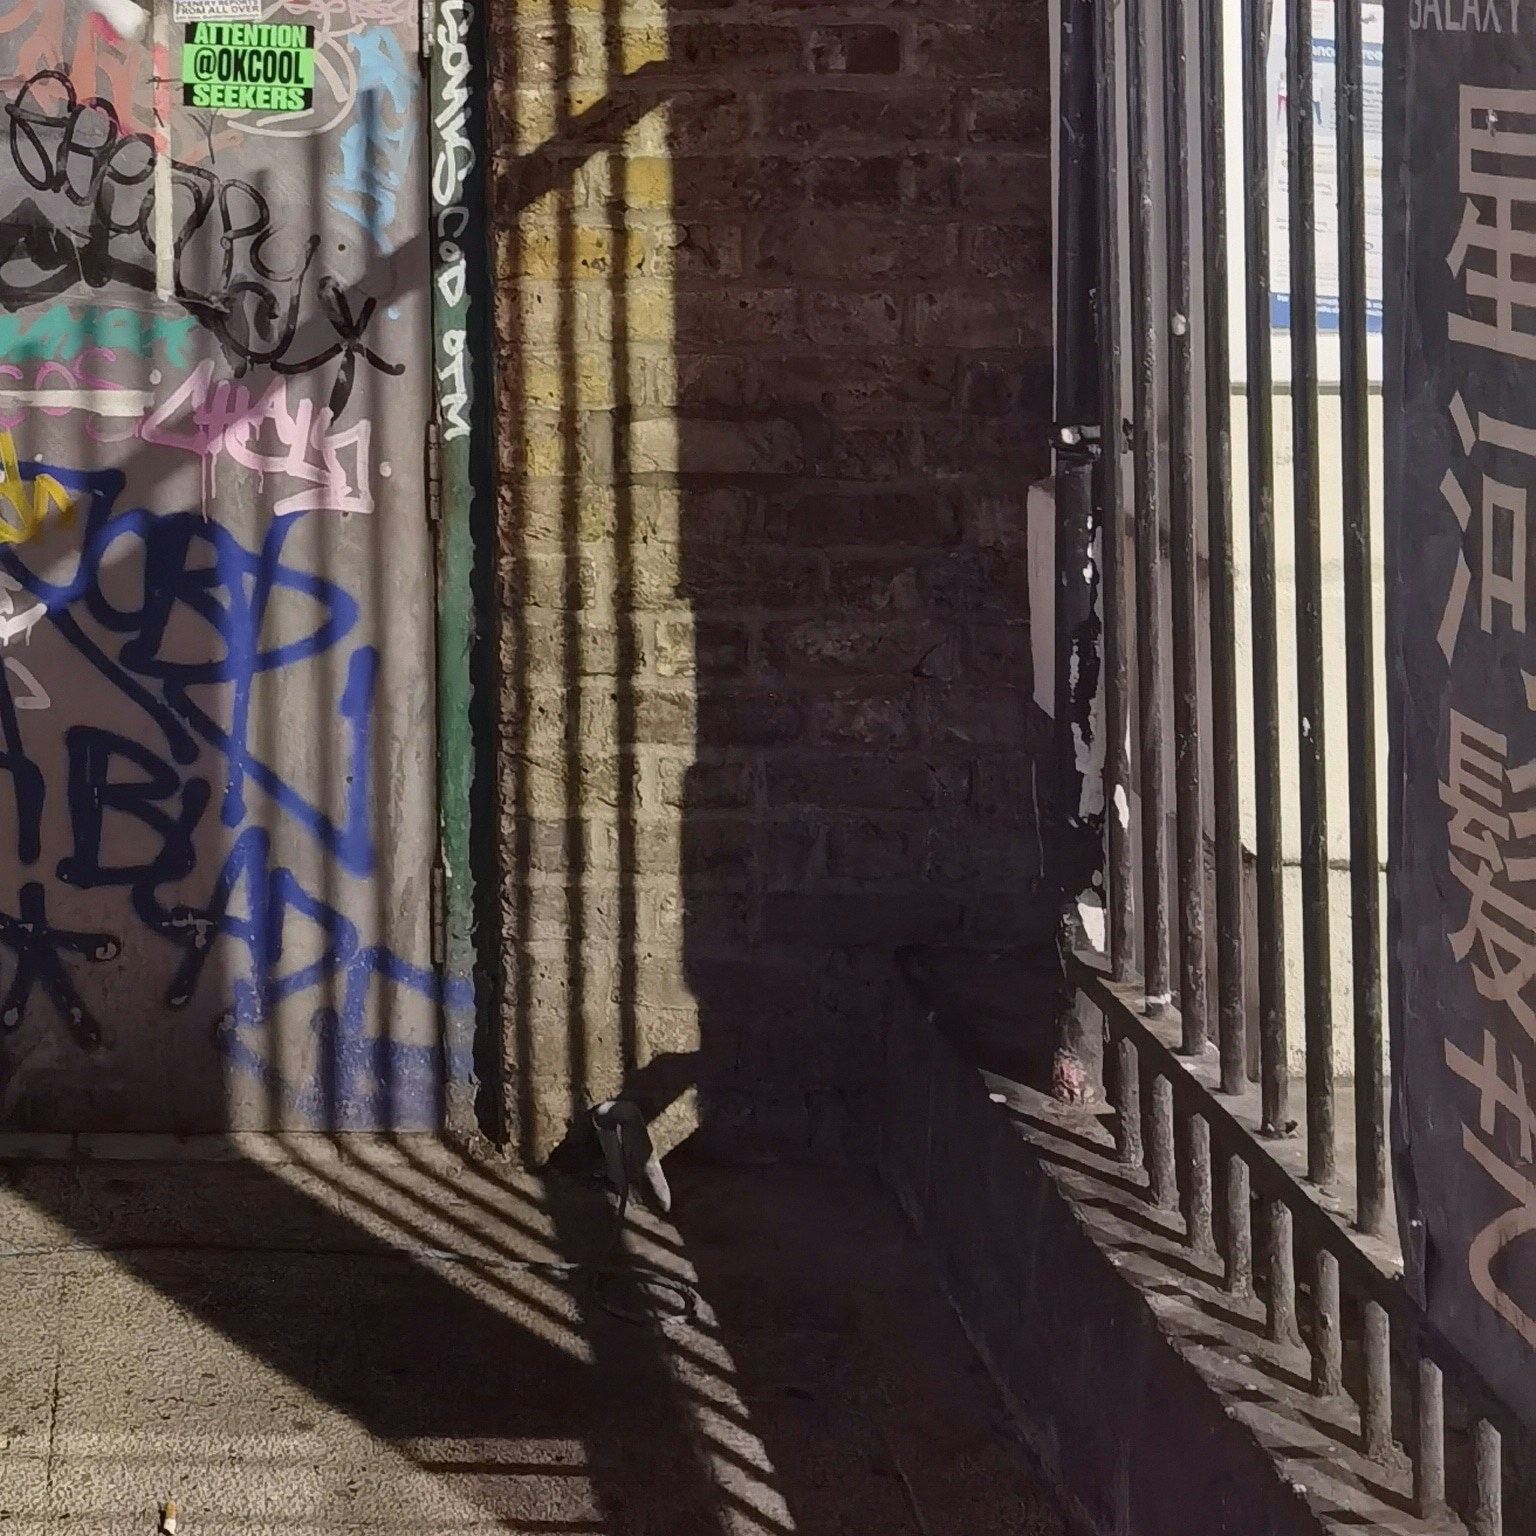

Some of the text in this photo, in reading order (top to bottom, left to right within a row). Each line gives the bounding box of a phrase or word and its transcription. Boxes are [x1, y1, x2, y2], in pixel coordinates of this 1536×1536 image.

[208, 5, 229, 14] ALL
[231, 4, 259, 13] OVER
[194, 23, 306, 48] ATTENTION
[194, 49, 305, 84] @OKCOOL
[192, 85, 305, 110] SEEKERS
